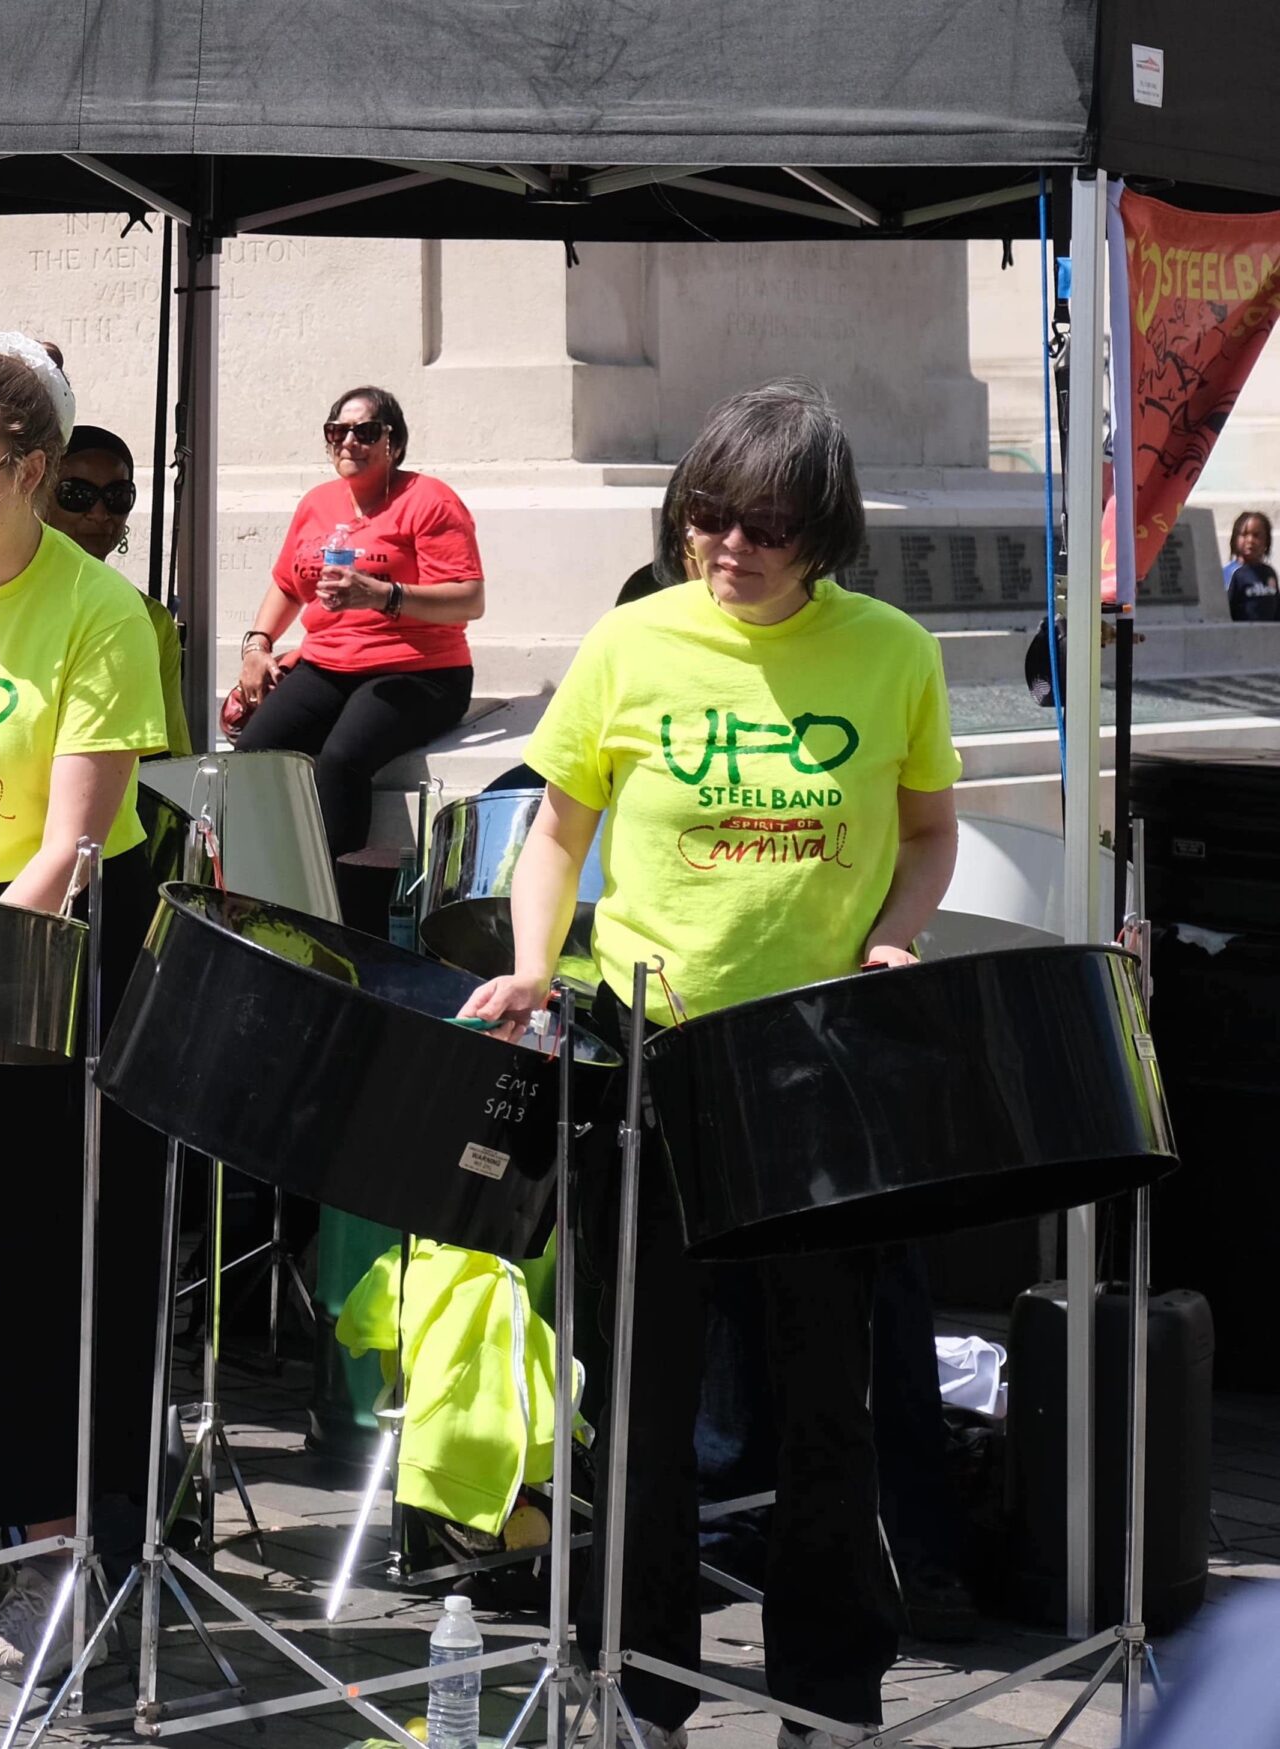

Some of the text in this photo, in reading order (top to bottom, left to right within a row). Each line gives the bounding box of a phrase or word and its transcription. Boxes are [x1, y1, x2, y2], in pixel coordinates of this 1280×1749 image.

[29, 247, 81, 272] THE
[92, 245, 150, 269] MEN
[660, 708, 860, 785] UFO
[697, 785, 843, 810] STEELBAND
[729, 819, 816, 832] SPIRIT OF
[677, 822, 854, 870] Carnival
[495, 1073, 539, 1097] EMS
